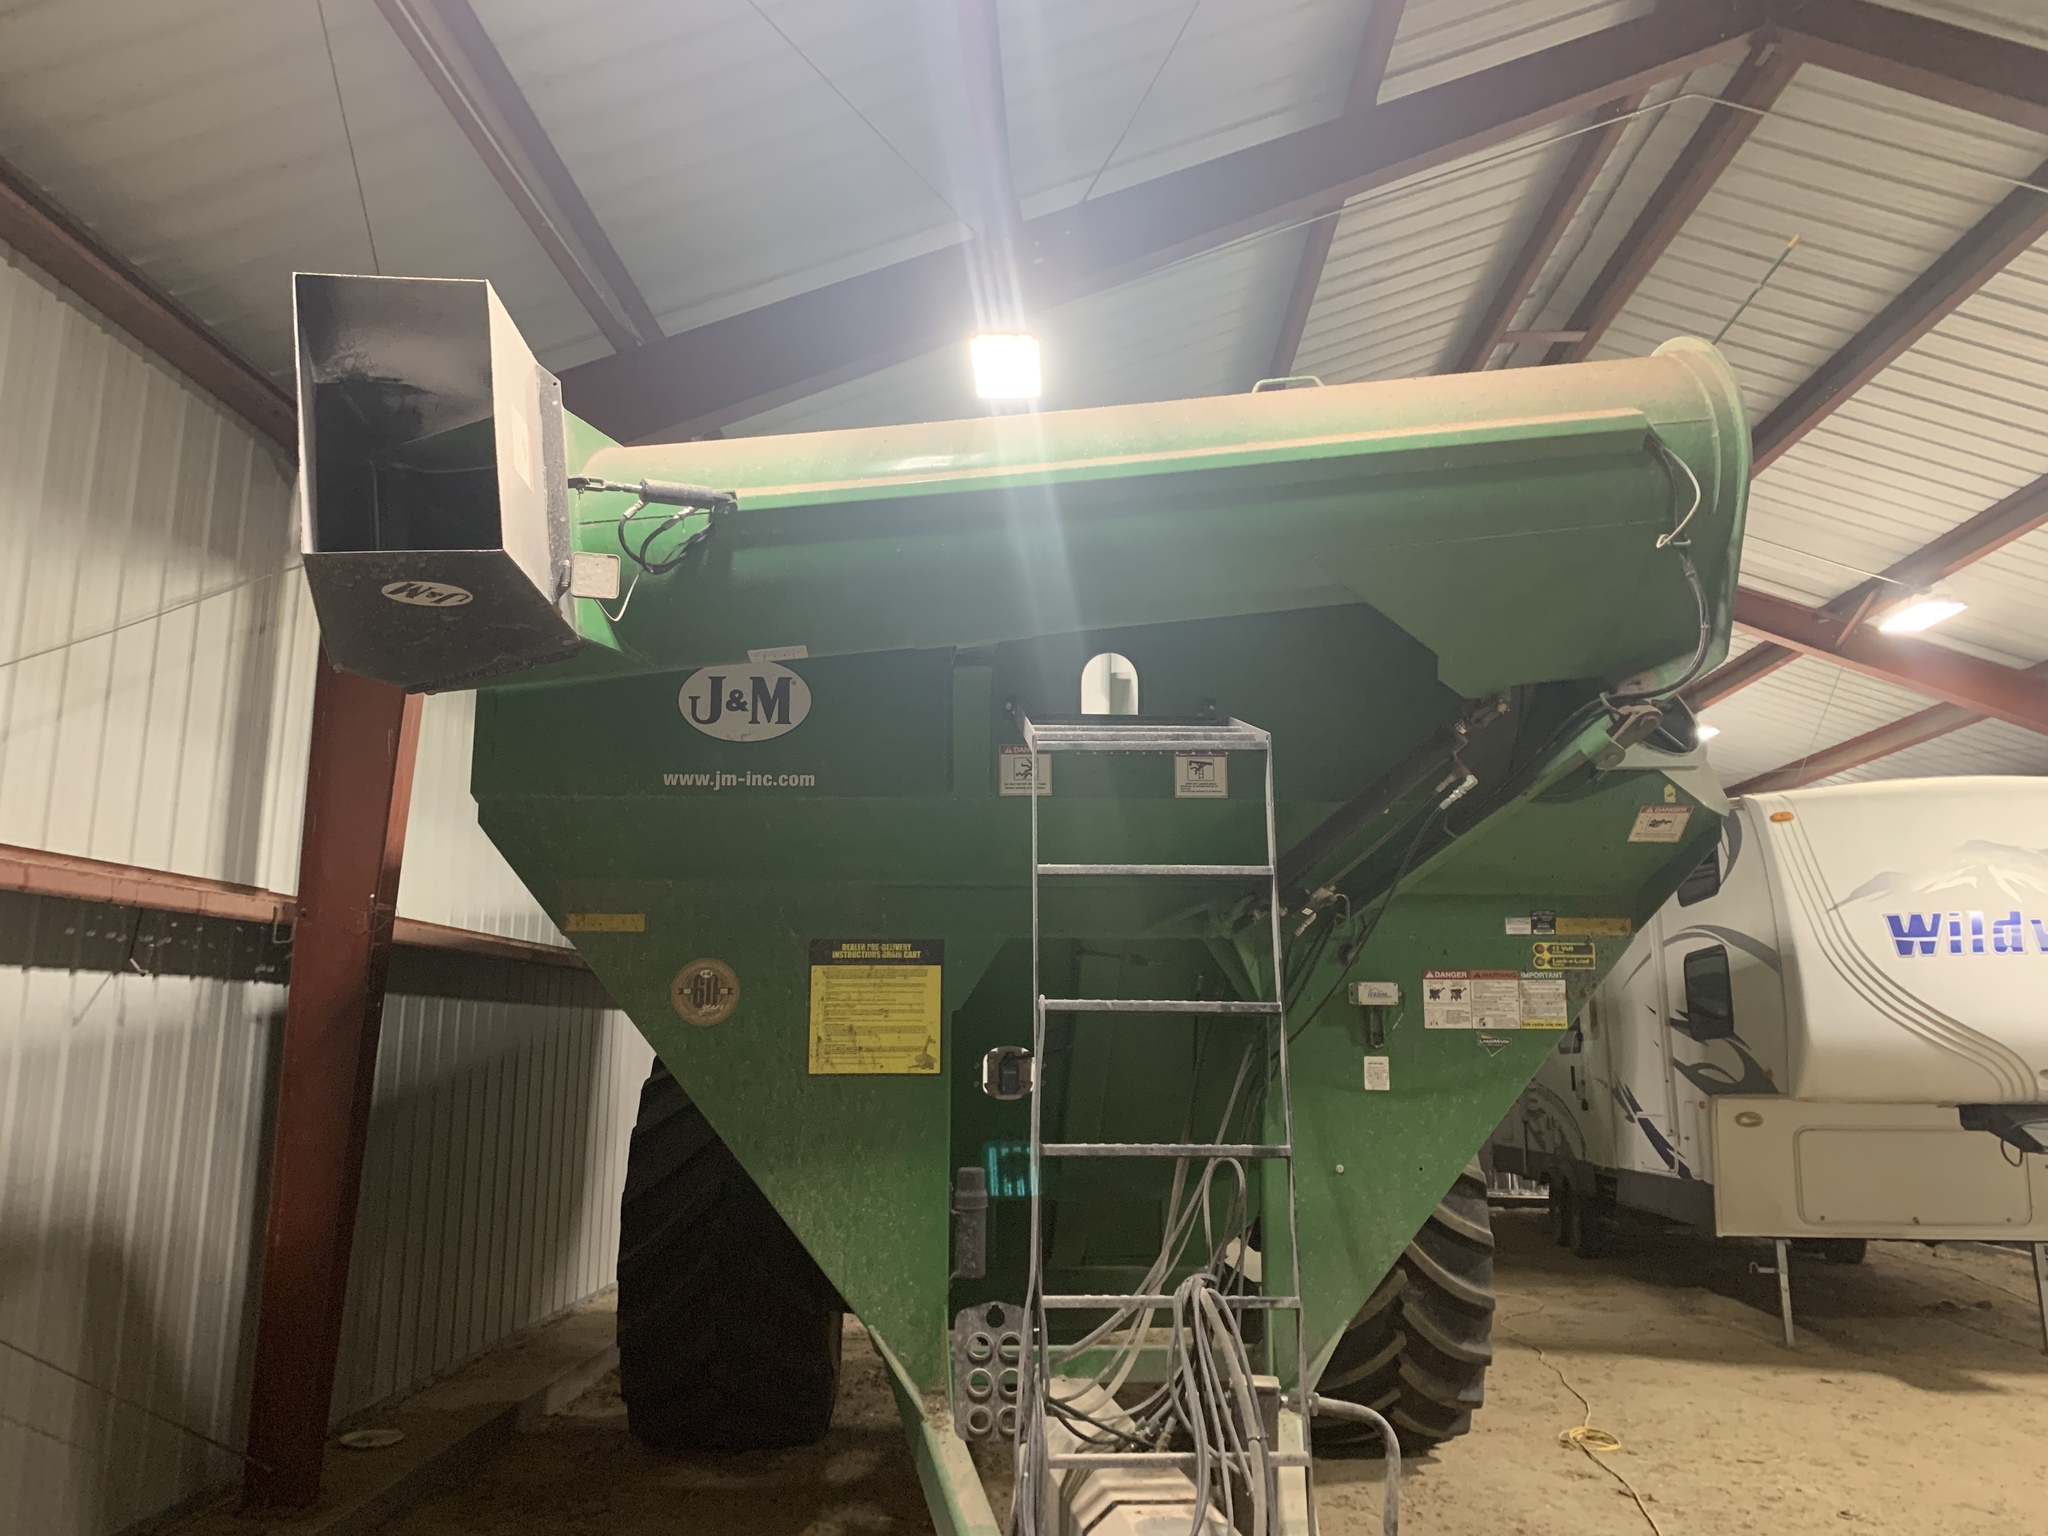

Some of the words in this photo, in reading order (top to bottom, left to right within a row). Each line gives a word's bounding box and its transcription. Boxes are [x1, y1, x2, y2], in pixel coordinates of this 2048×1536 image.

[387, 583, 471, 604] J&M
[688, 676, 794, 725] J&M
[663, 771, 816, 791] www.jm-inc.com
[841, 943, 867, 951] DEALER
[832, 951, 881, 959] INSTRUCTIONS
[903, 951, 922, 959] CART
[1434, 971, 1467, 979] DANGER
[1520, 971, 1563, 979] IMPORTANT
